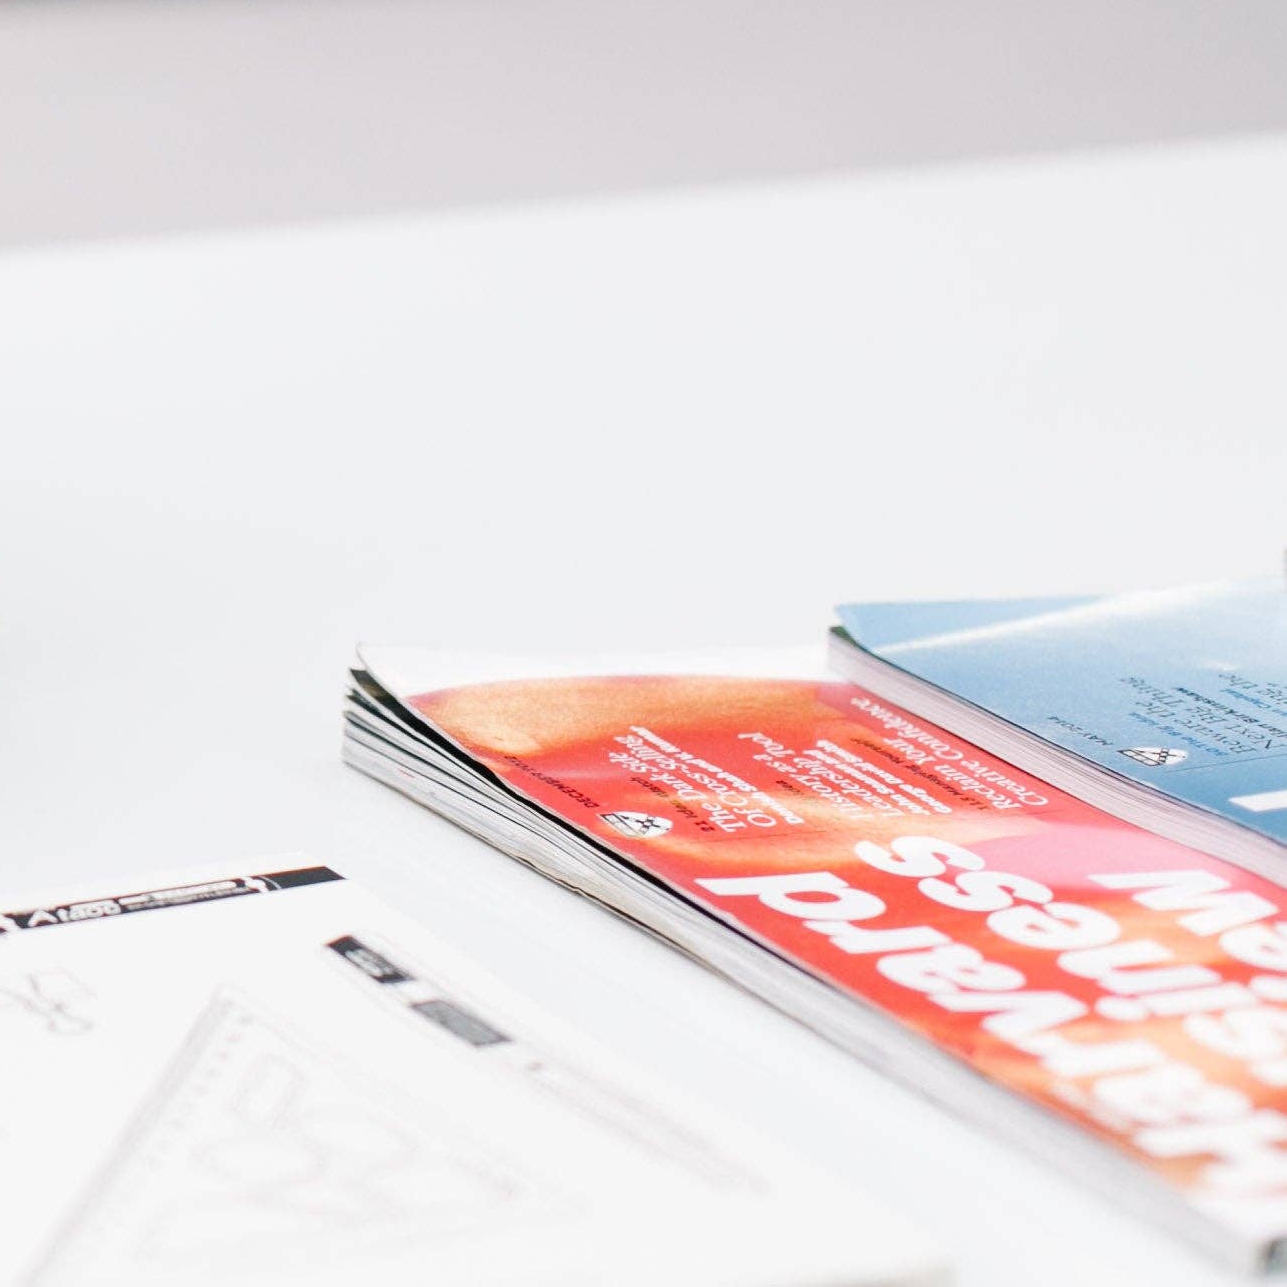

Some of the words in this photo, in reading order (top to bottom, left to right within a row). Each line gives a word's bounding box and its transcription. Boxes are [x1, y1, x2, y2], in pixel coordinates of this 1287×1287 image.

[1119, 677, 1188, 707] Thing
[1134, 700, 1177, 717] the
[1182, 706, 1227, 723] Big
[850, 696, 964, 761] Confidence
[1173, 719, 1259, 753] Beware
[1221, 724, 1285, 749] Next
[733, 732, 796, 757] Tool
[882, 737, 931, 765] Your
[764, 759, 798, 772] as
[647, 772, 709, 801] Dark
[790, 759, 905, 817] Leadership
[931, 763, 1023, 809] Reclaim
[957, 758, 1052, 805] Creative
[699, 802, 749, 832] The
[731, 808, 780, 826] Of
